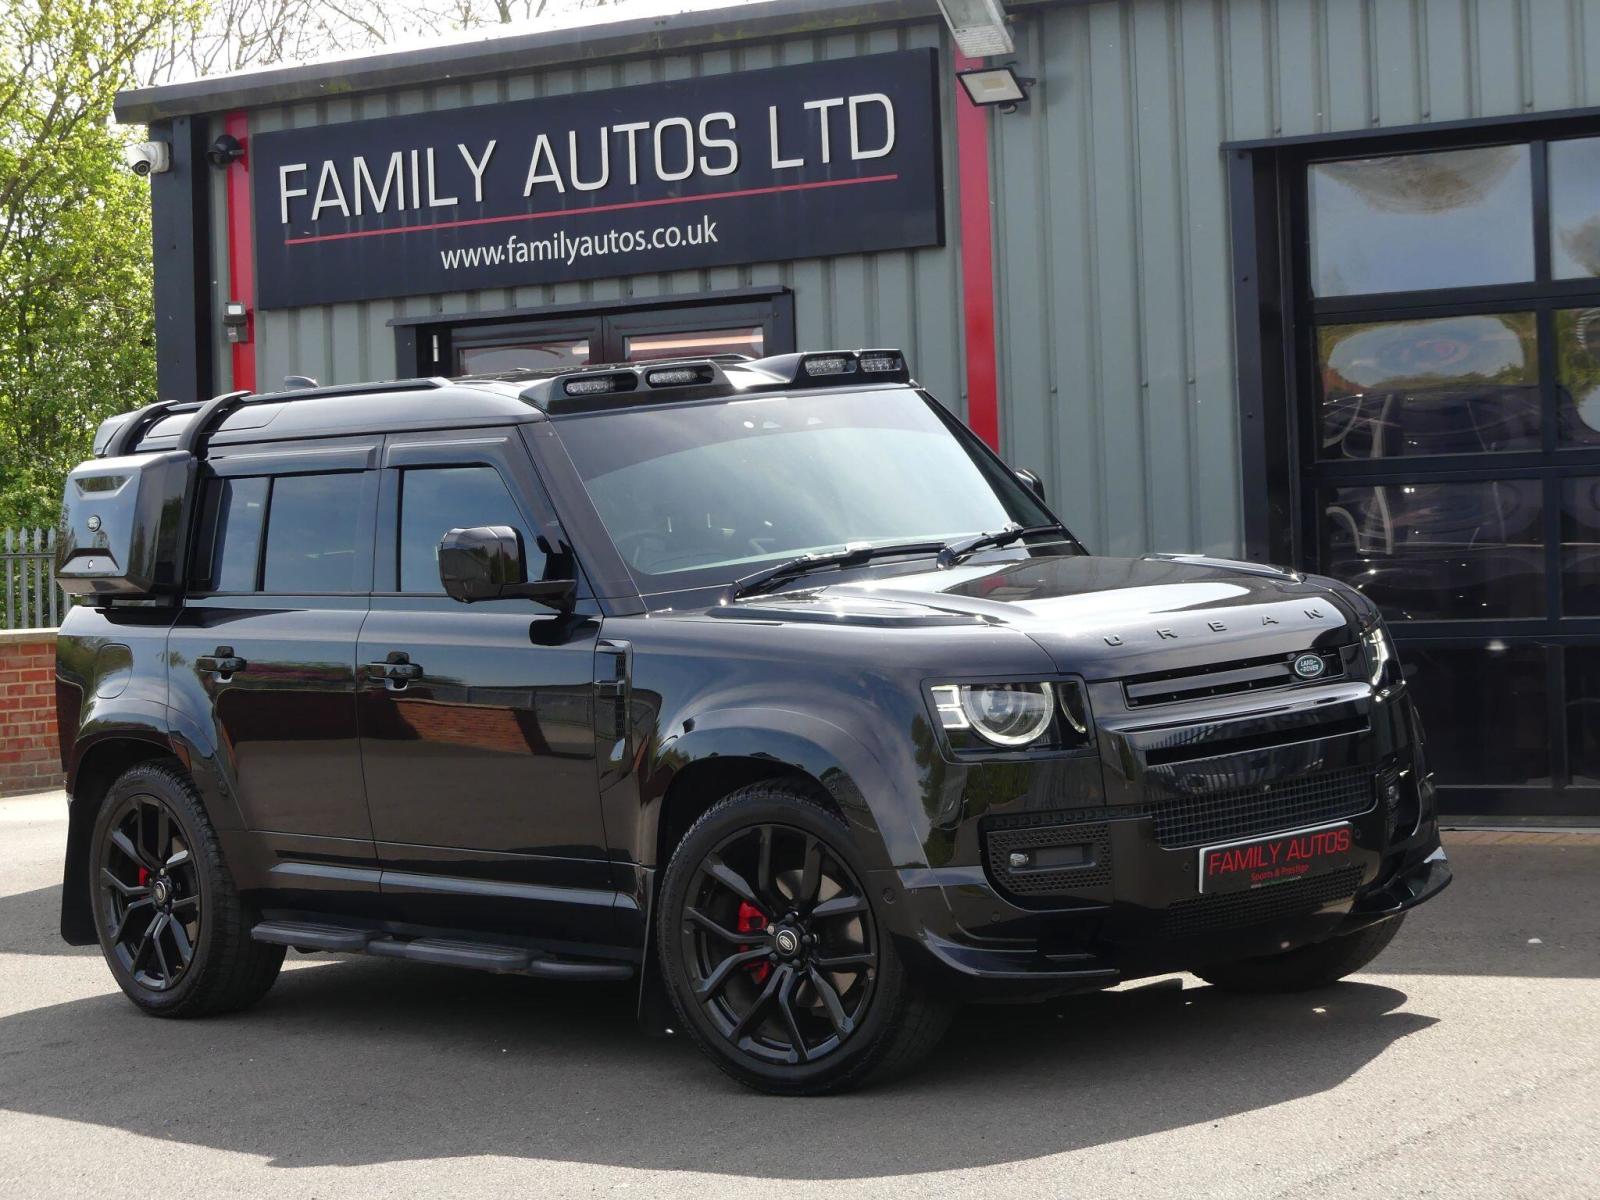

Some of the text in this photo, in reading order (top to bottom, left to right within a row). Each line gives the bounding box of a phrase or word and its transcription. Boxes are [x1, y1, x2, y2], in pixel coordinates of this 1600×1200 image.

[278, 92, 896, 225] FAMILY AUTOS LTD
[440, 214, 719, 270] www.familyautos.co.uk
[1208, 829, 1350, 876] FAMILY AUTOS
